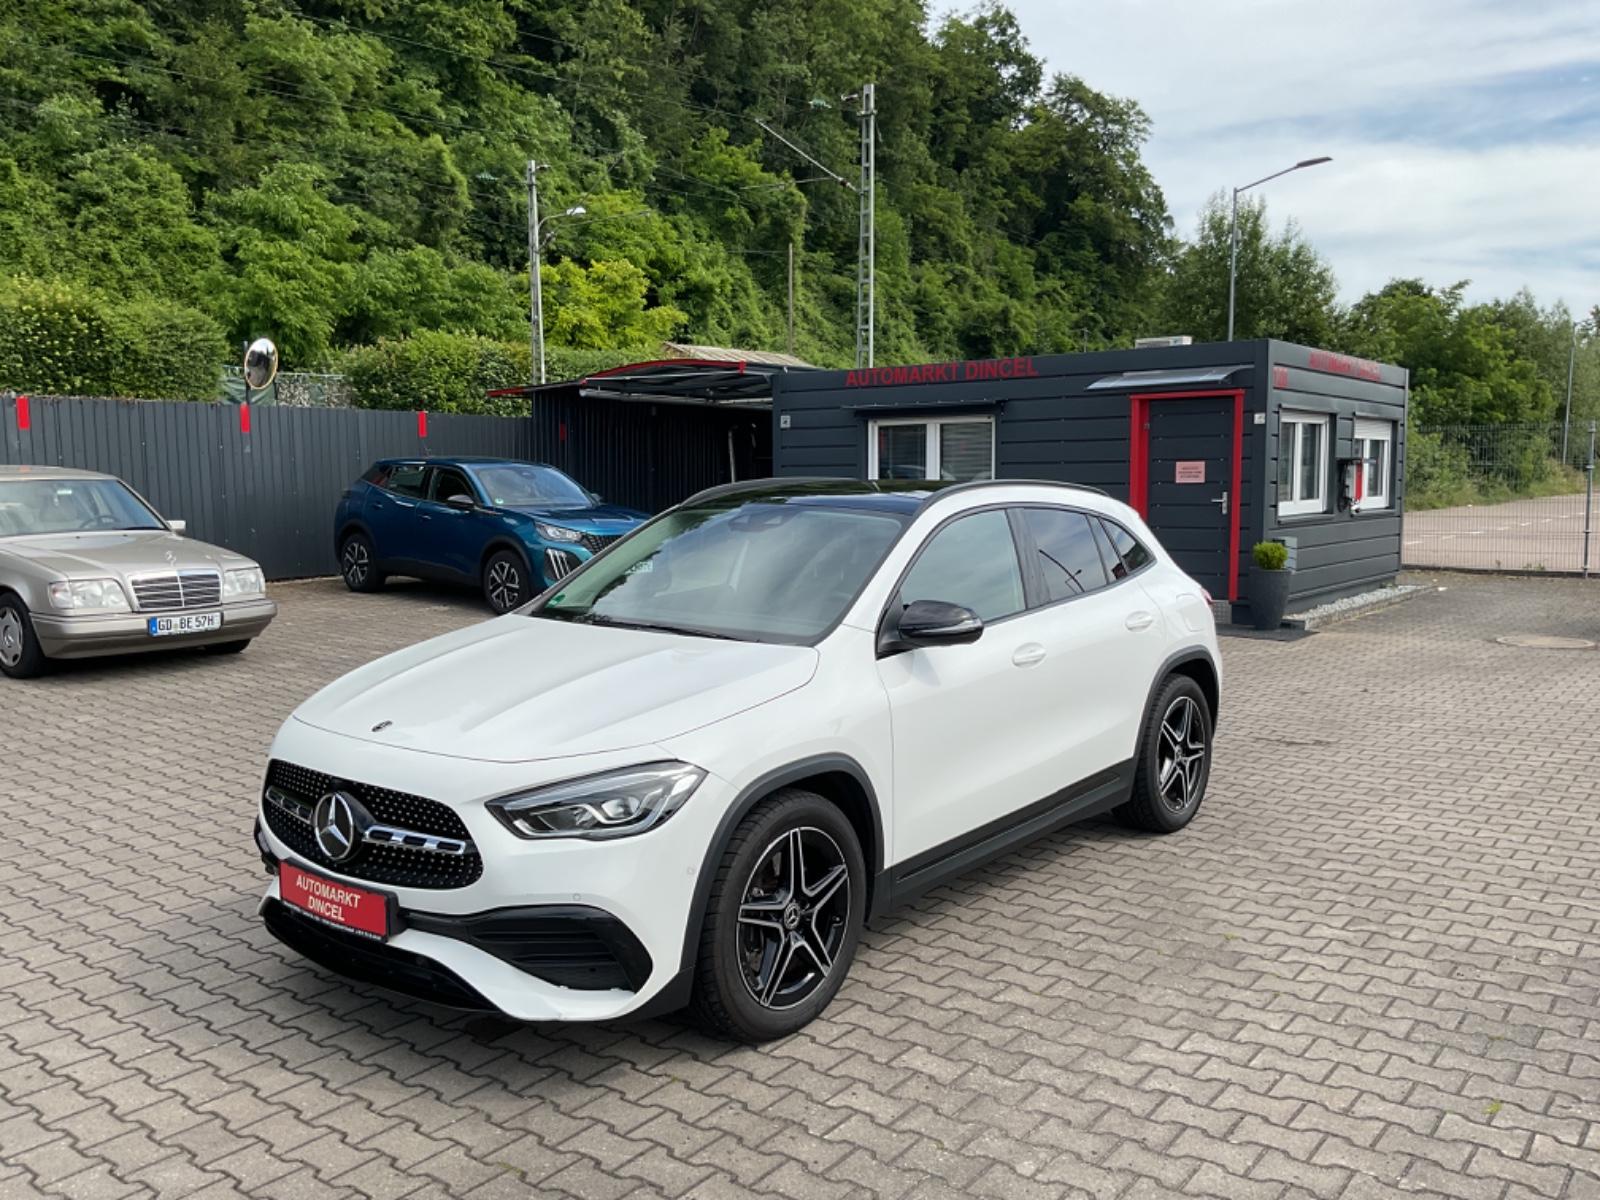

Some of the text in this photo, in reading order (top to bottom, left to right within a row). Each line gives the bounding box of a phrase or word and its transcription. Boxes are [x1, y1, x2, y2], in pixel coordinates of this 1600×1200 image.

[846, 357, 1038, 387] AUTOMARKT DINCEL
[158, 618, 172, 631] GD
[180, 617, 193, 629] BE
[296, 874, 361, 908] AUTOMARKT
[308, 896, 345, 921] DINCEL
